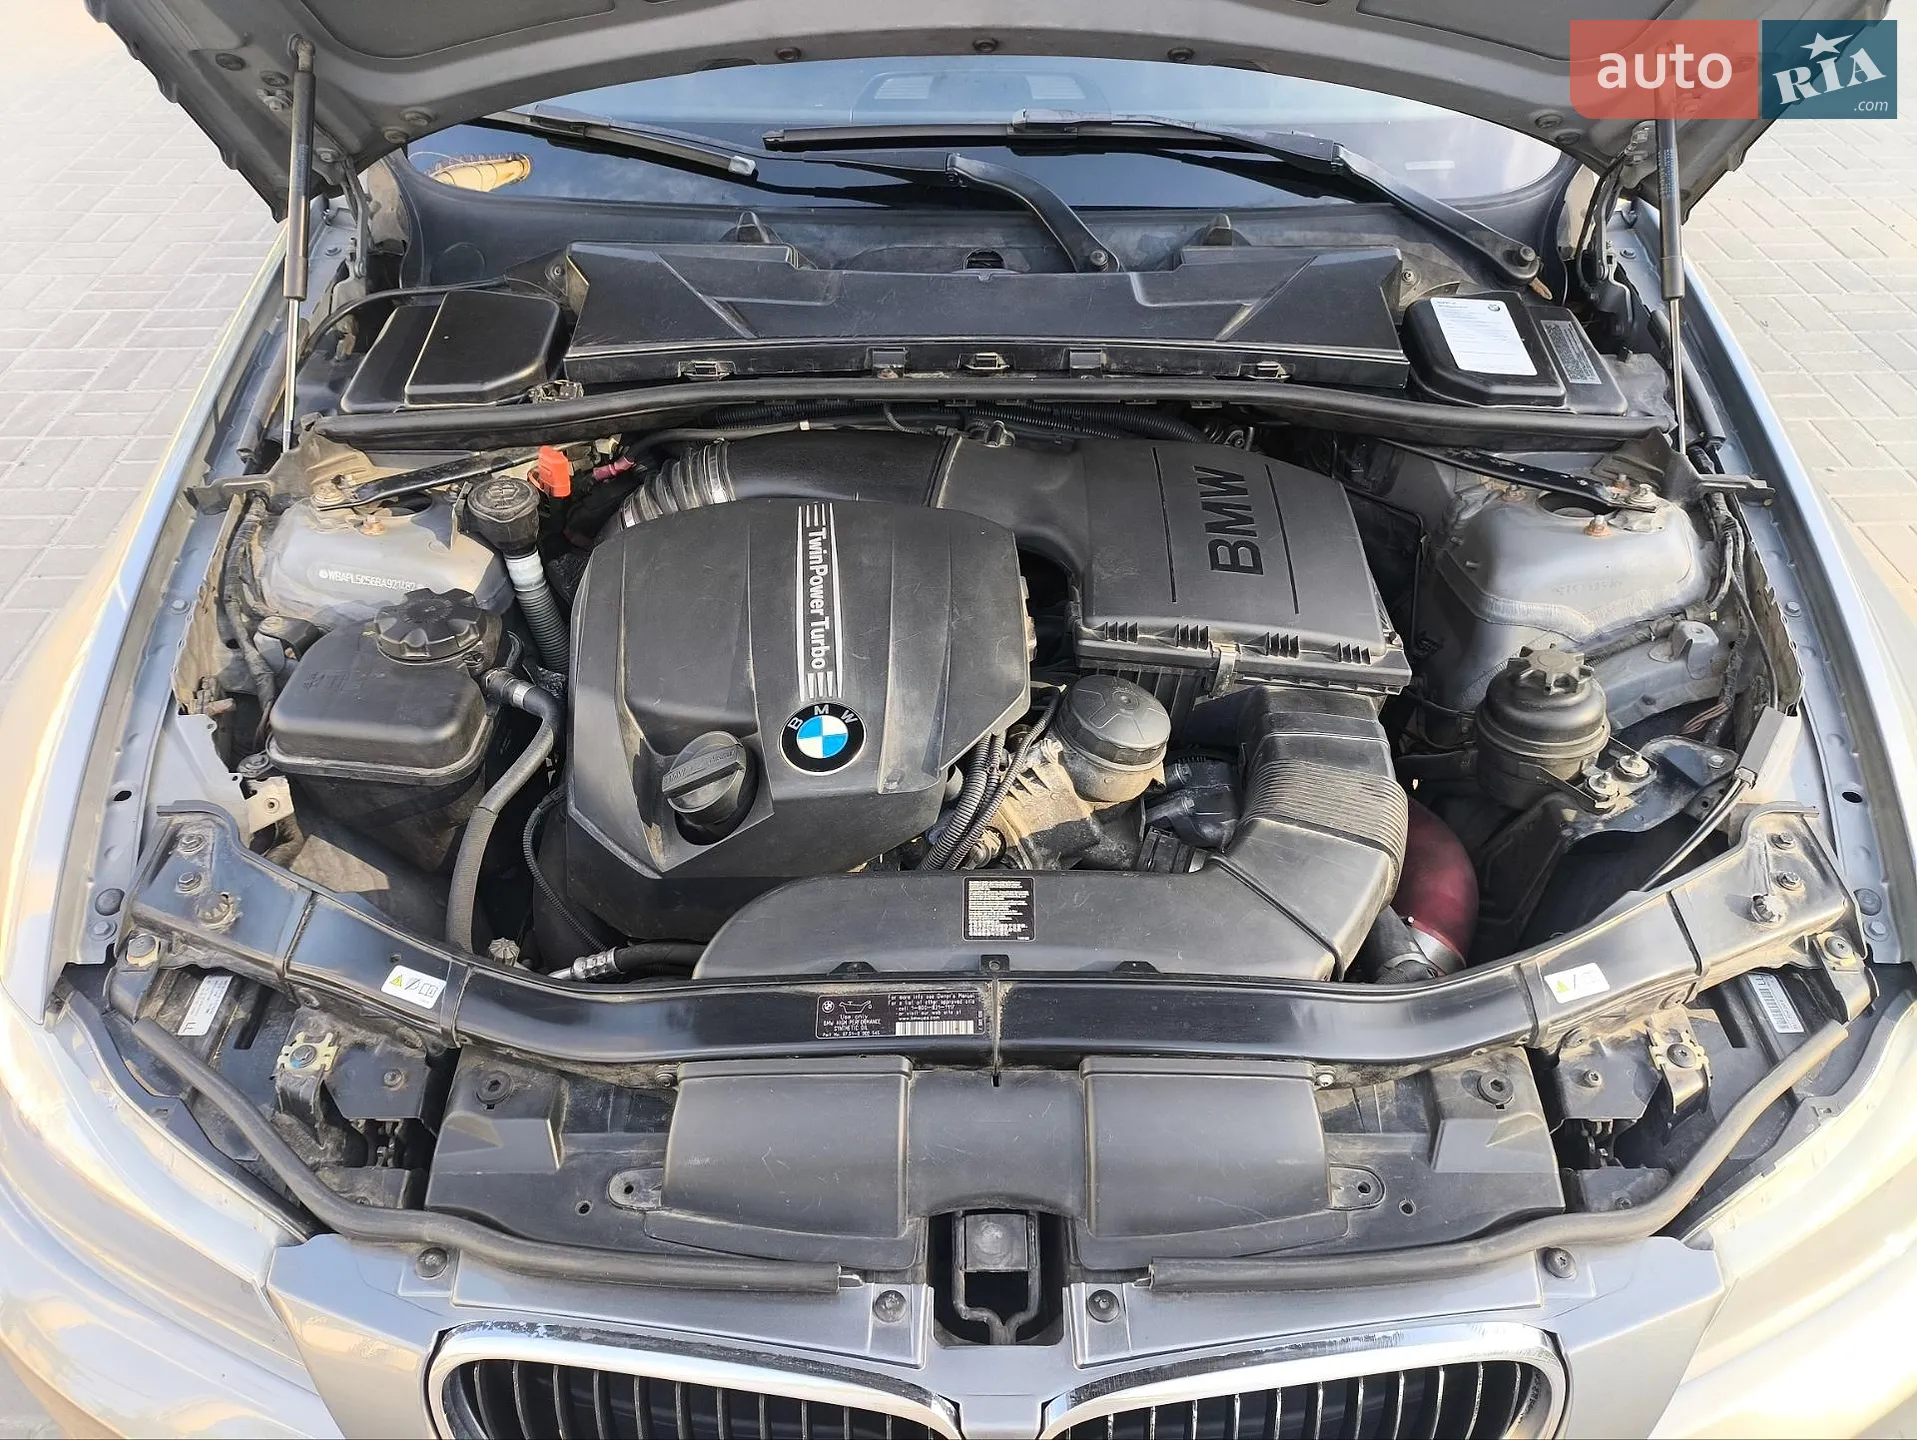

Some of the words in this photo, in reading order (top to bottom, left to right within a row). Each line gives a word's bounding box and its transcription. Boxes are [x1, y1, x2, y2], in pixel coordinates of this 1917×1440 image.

[1193, 465, 1264, 576] BMW
[806, 527, 829, 616] TwinPower
[810, 616, 830, 669] Turbo
[789, 704, 858, 731] BMW
